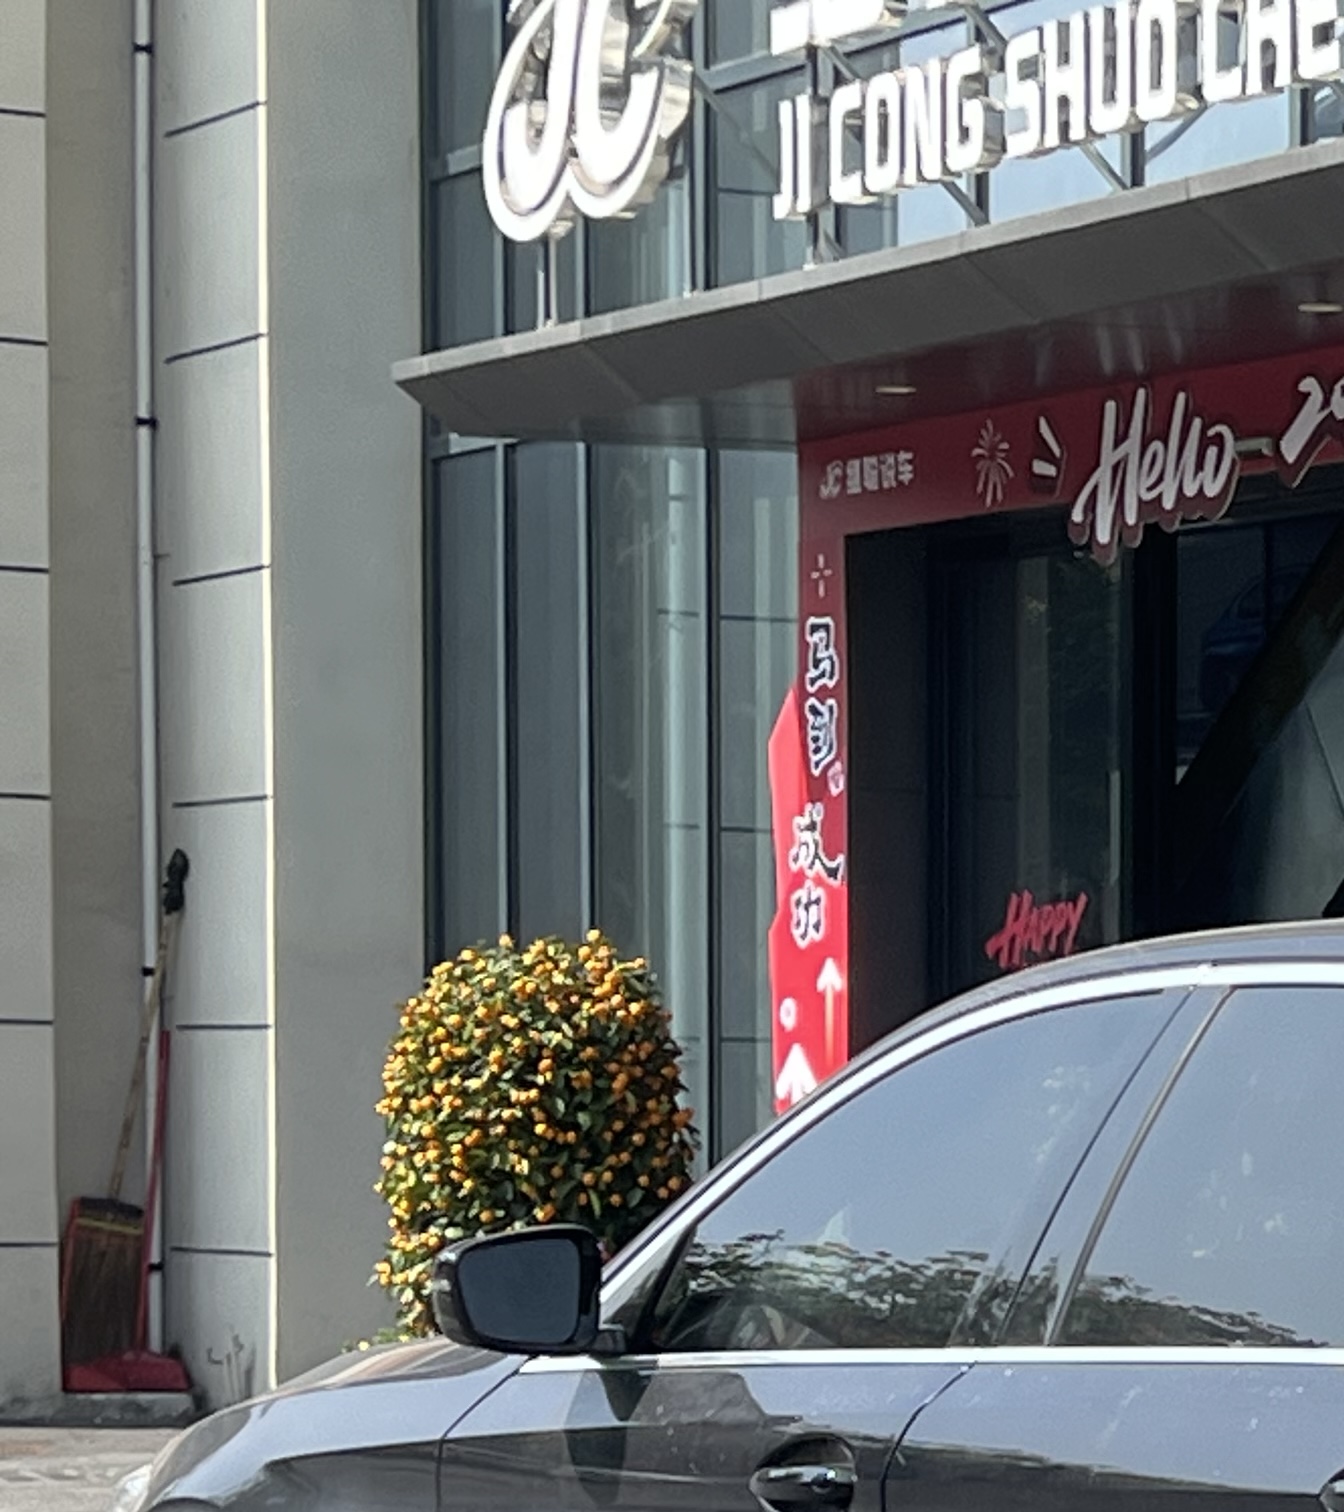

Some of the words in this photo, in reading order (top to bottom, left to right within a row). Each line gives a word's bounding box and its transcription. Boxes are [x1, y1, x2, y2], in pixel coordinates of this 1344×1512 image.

[772, 93, 814, 220] JI
[829, 44, 985, 205] CONG
[1005, 0, 1178, 158] SHUO
[1071, 387, 1235, 546] Hello
